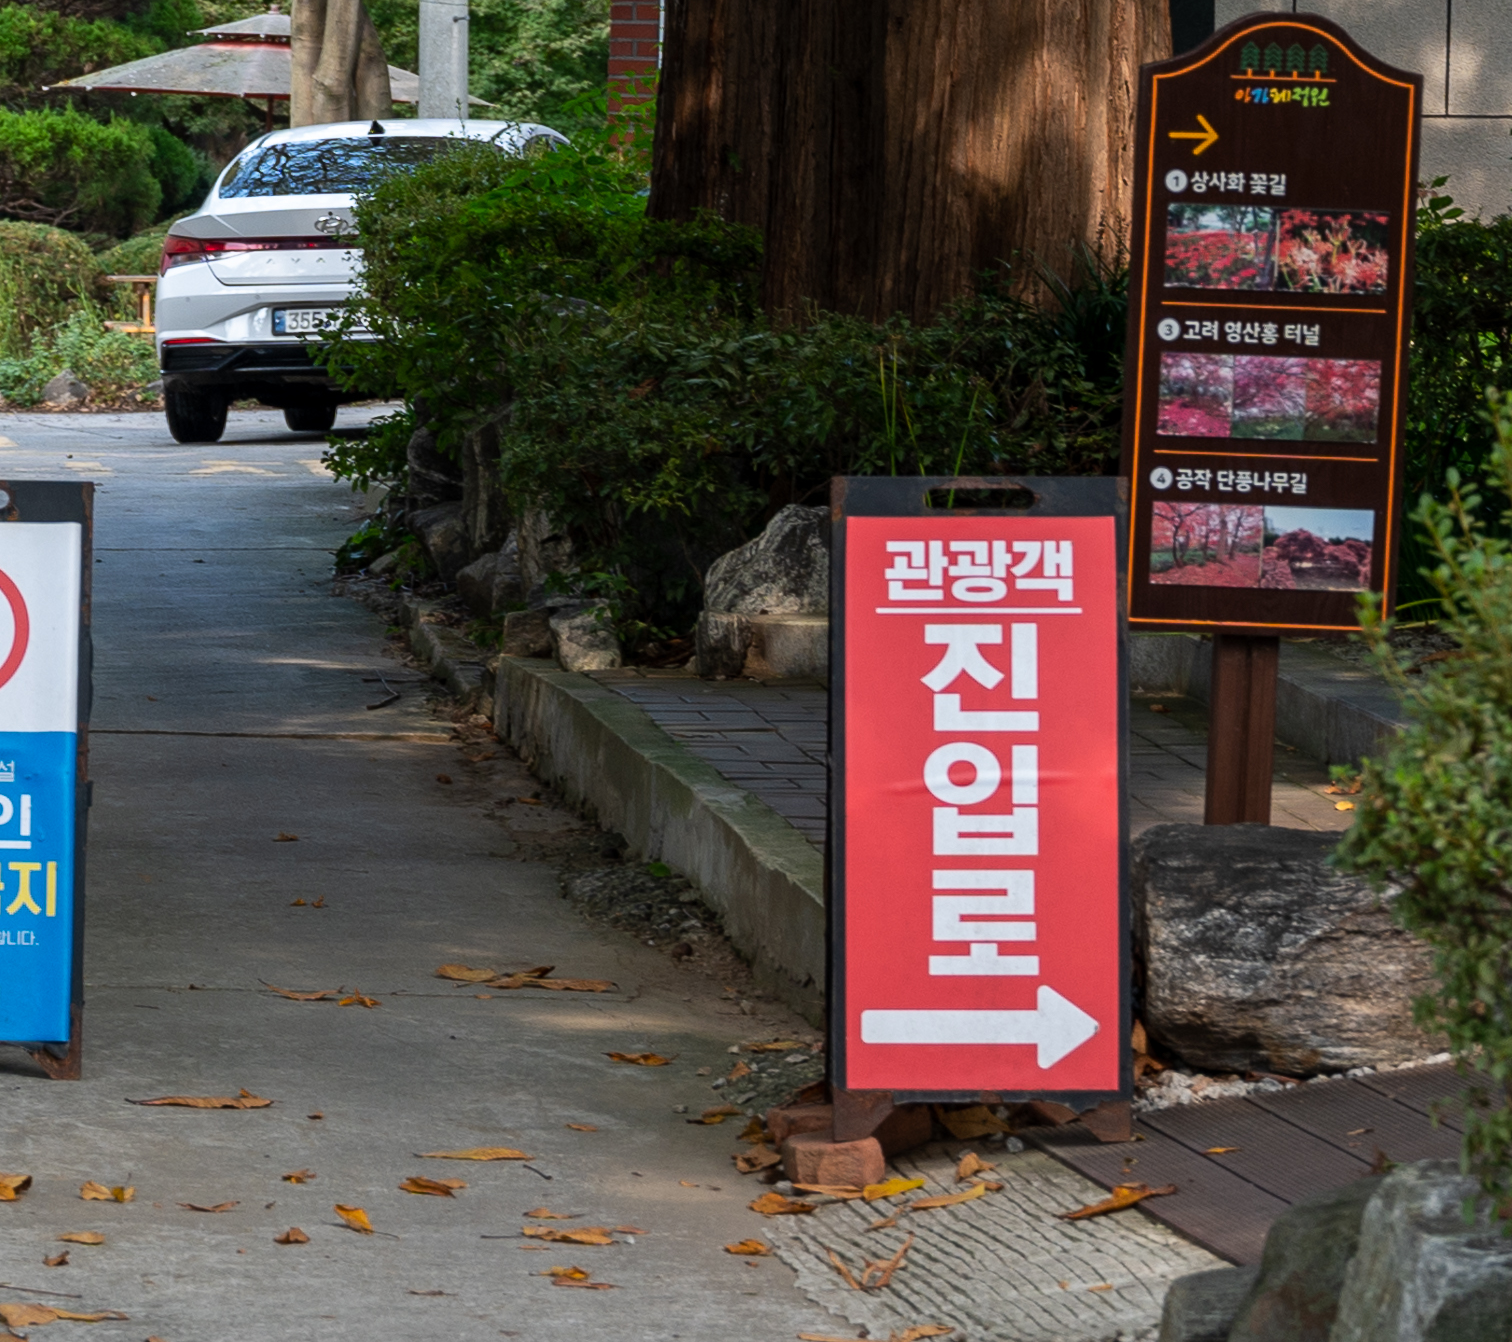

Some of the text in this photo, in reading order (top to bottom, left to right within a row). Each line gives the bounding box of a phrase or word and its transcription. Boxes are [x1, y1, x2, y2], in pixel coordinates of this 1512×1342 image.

[1191, 170, 1246, 193] 상사화
[1249, 172, 1287, 195] 꽃길
[1183, 320, 1219, 340] 고려
[1225, 321, 1279, 344] 영산홍
[1284, 324, 1320, 346] 터널
[1175, 468, 1212, 490] 공작
[1216, 470, 1307, 494] 단풍나무길
[884, 540, 1074, 602] 관광객
[920, 622, 1040, 976] 진입로
